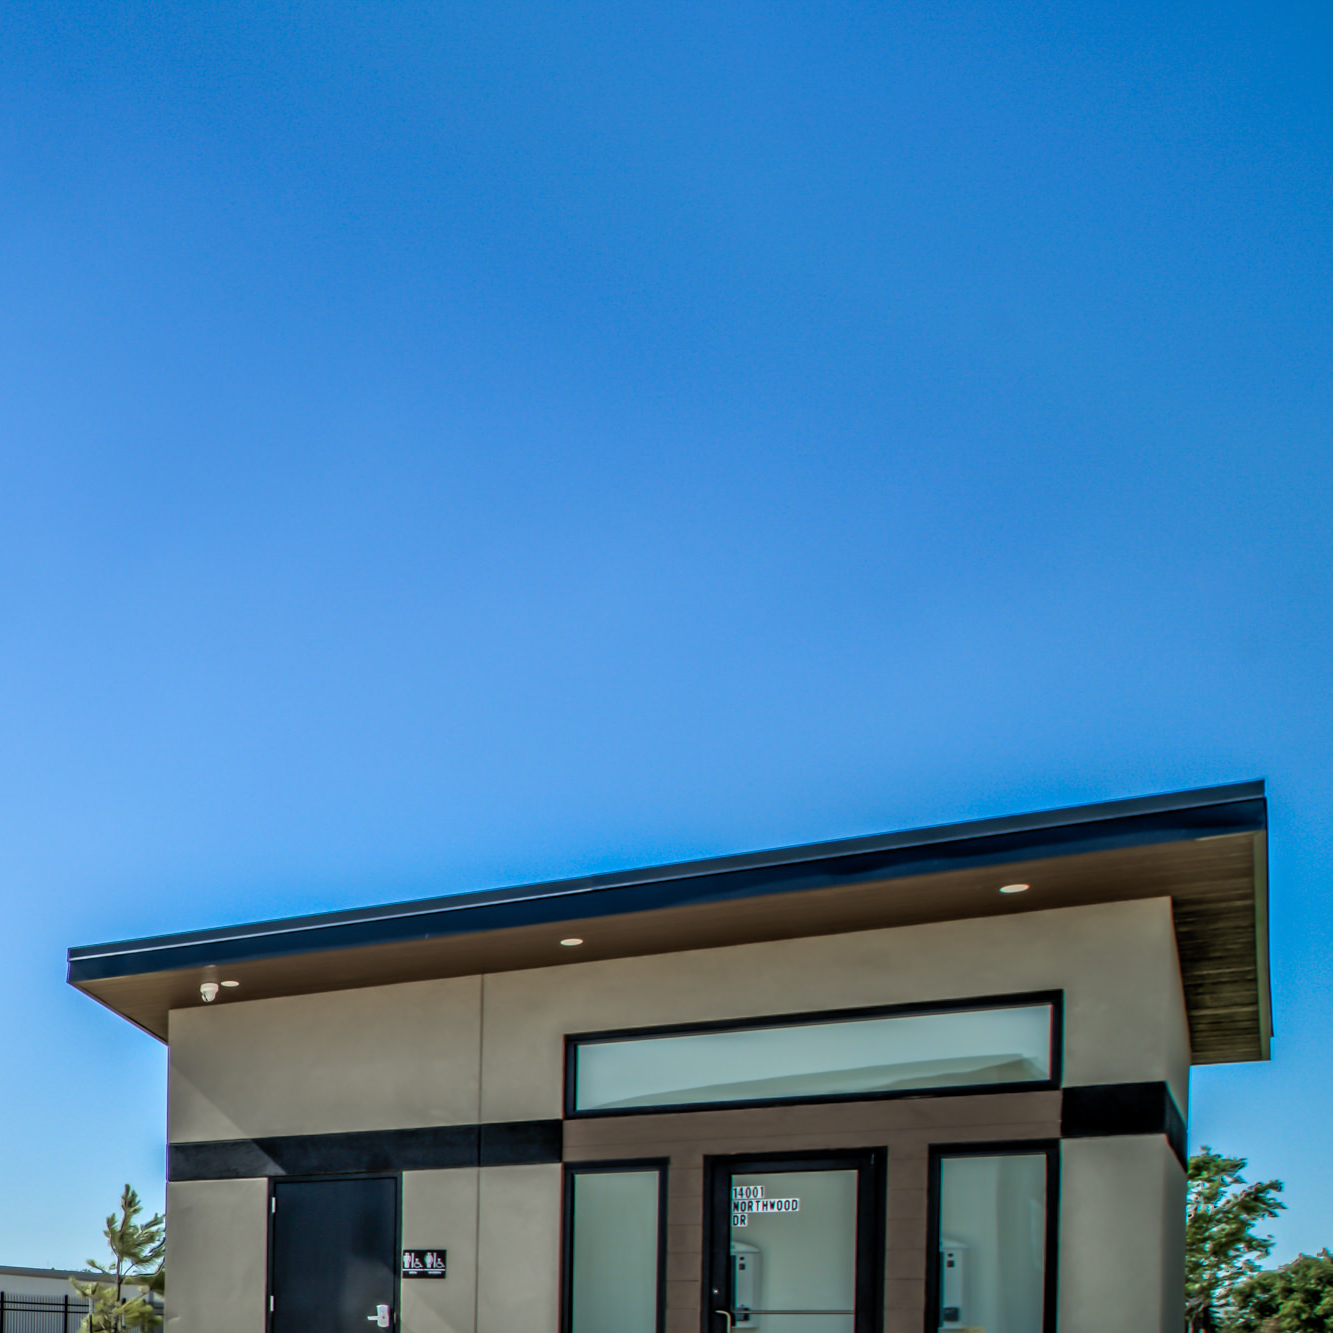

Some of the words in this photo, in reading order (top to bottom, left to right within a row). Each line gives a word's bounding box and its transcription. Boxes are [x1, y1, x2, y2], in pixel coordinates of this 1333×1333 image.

[733, 1186, 764, 1199] 14001
[733, 1199, 798, 1212] NORTHWOOD
[733, 1214, 747, 1226] DR
